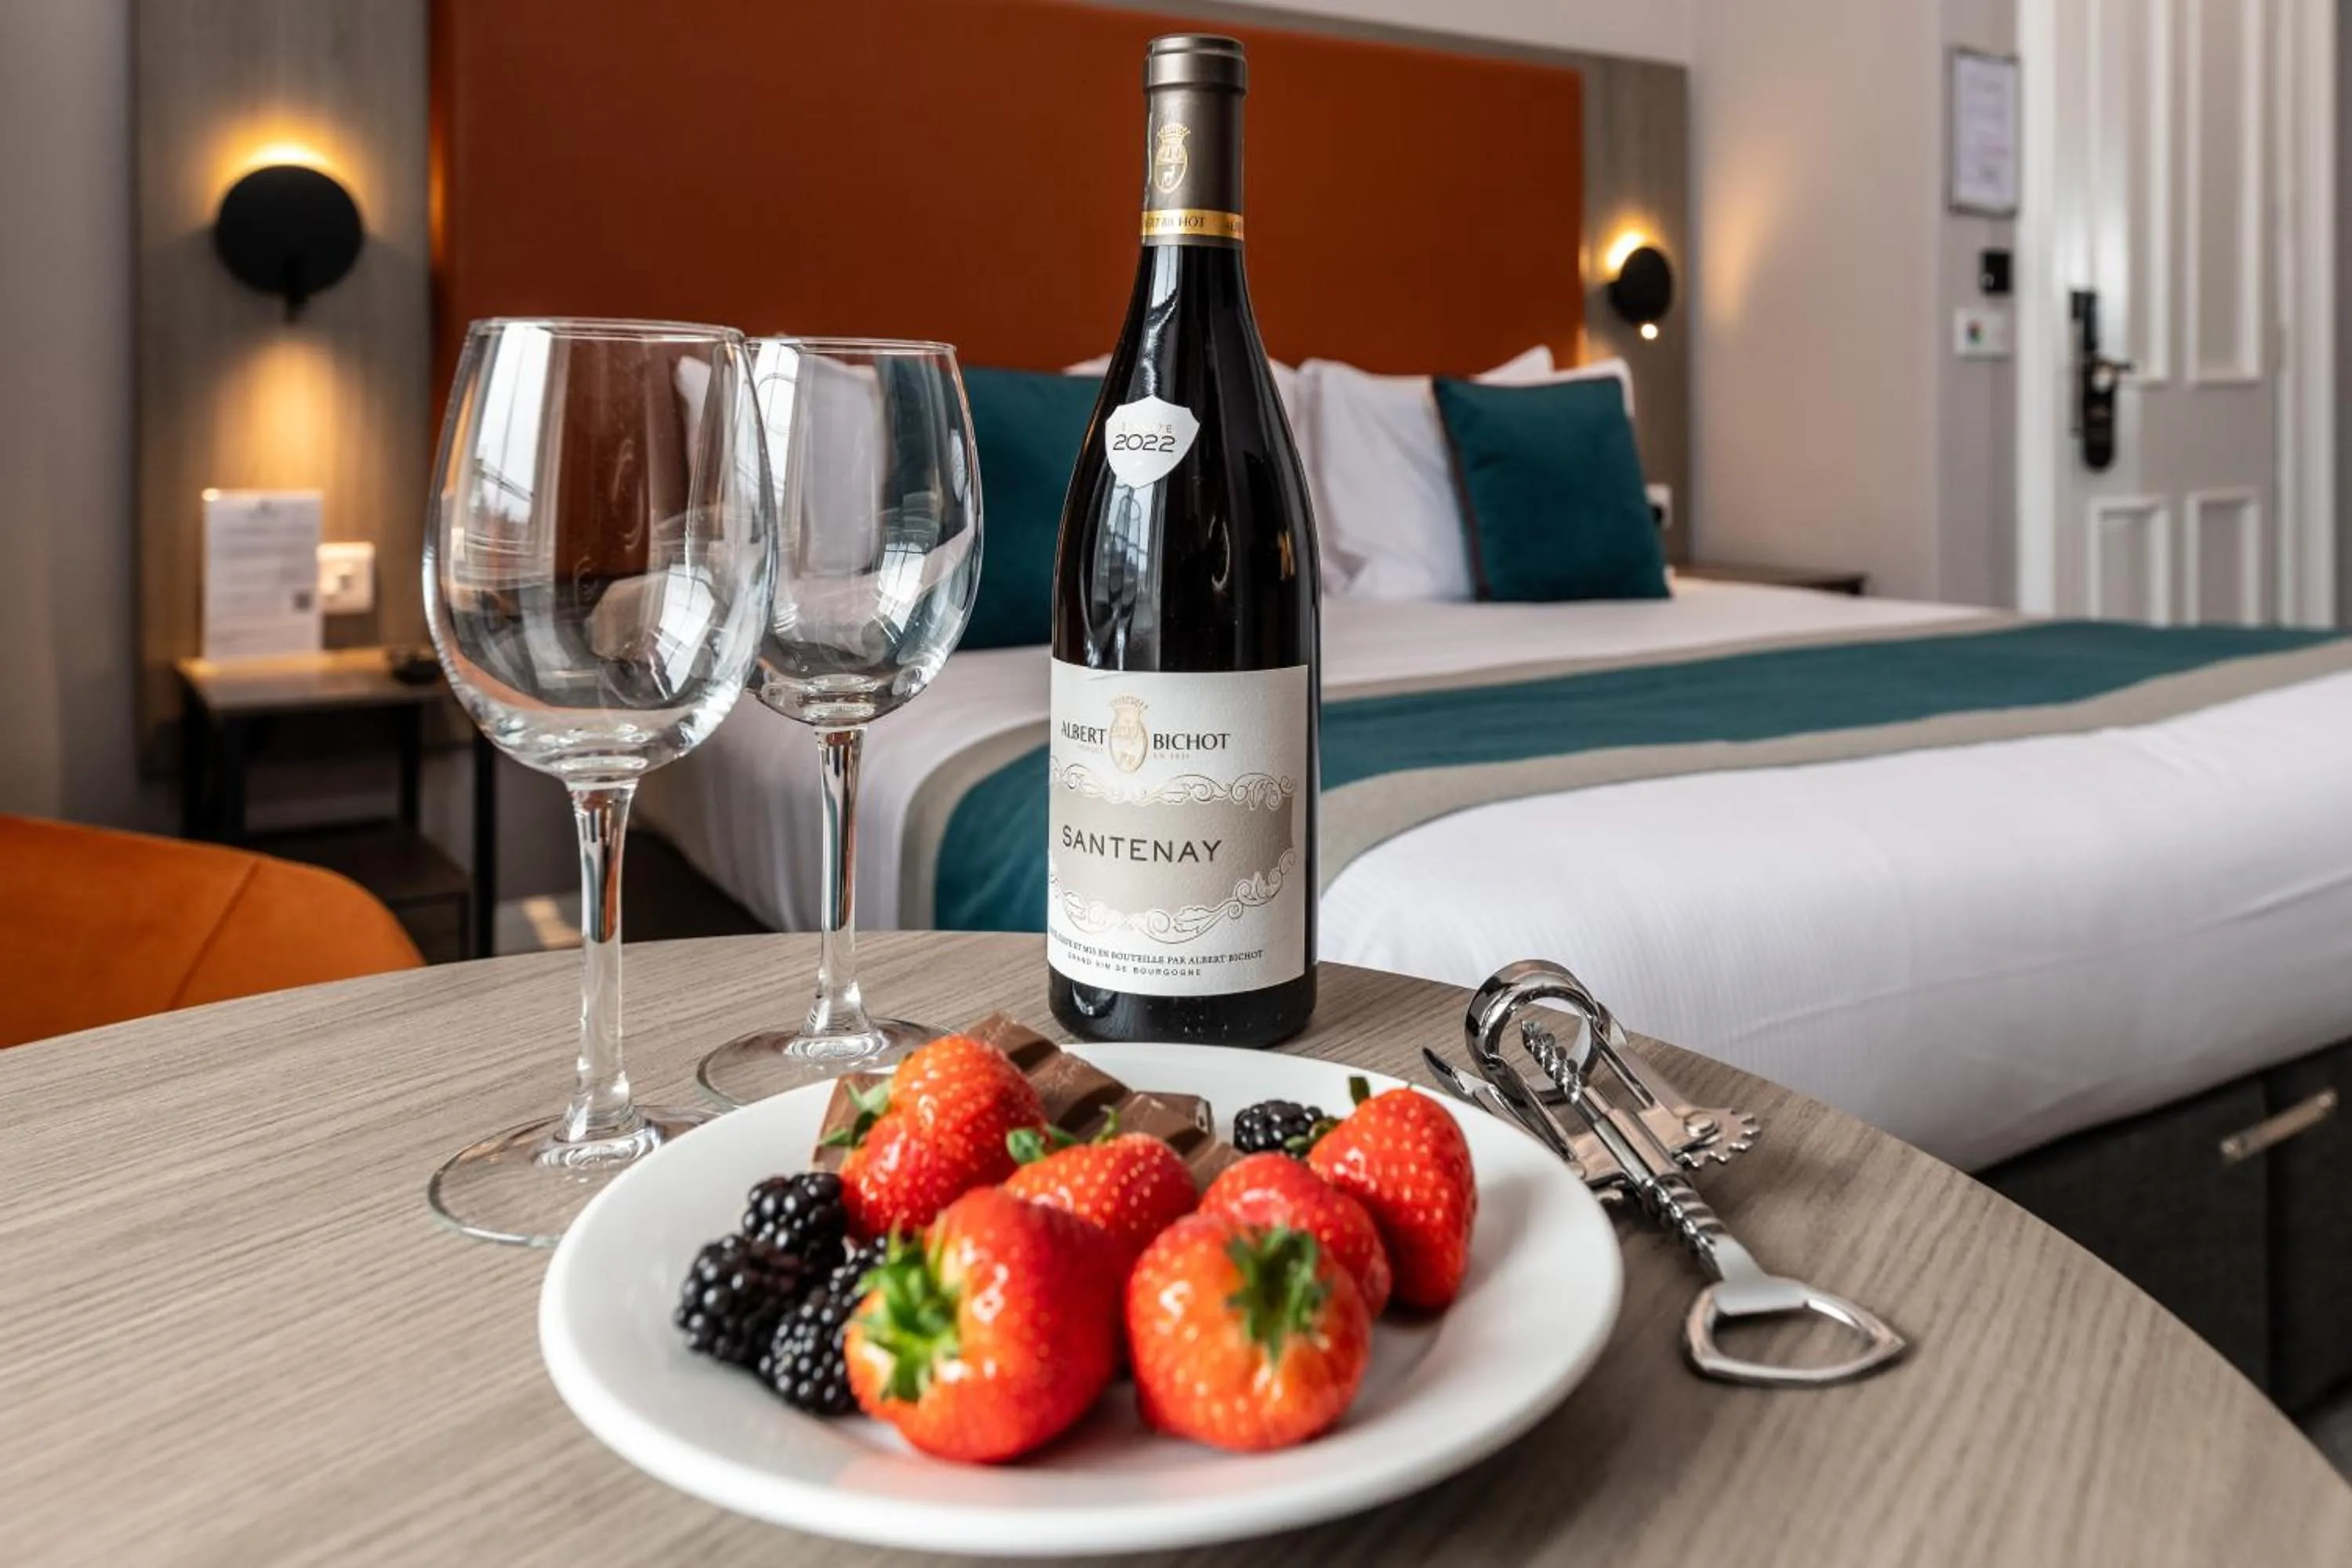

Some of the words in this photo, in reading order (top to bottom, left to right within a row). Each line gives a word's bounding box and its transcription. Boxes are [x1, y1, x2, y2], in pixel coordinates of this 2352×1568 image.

[1113, 434, 1176, 452] 2022
[1062, 720, 1106, 745] ALBERT
[1153, 733, 1231, 750] BICHOT
[1062, 825, 1221, 862] SANTENAY
[1111, 951, 1164, 964] BOUTEILLE
[1167, 954, 1185, 964] PAR
[1188, 954, 1226, 964] ALBERT
[1229, 949, 1264, 962] BICHOT
[1116, 964, 1127, 973] DE
[1133, 967, 1201, 977] BOURGOGNE
